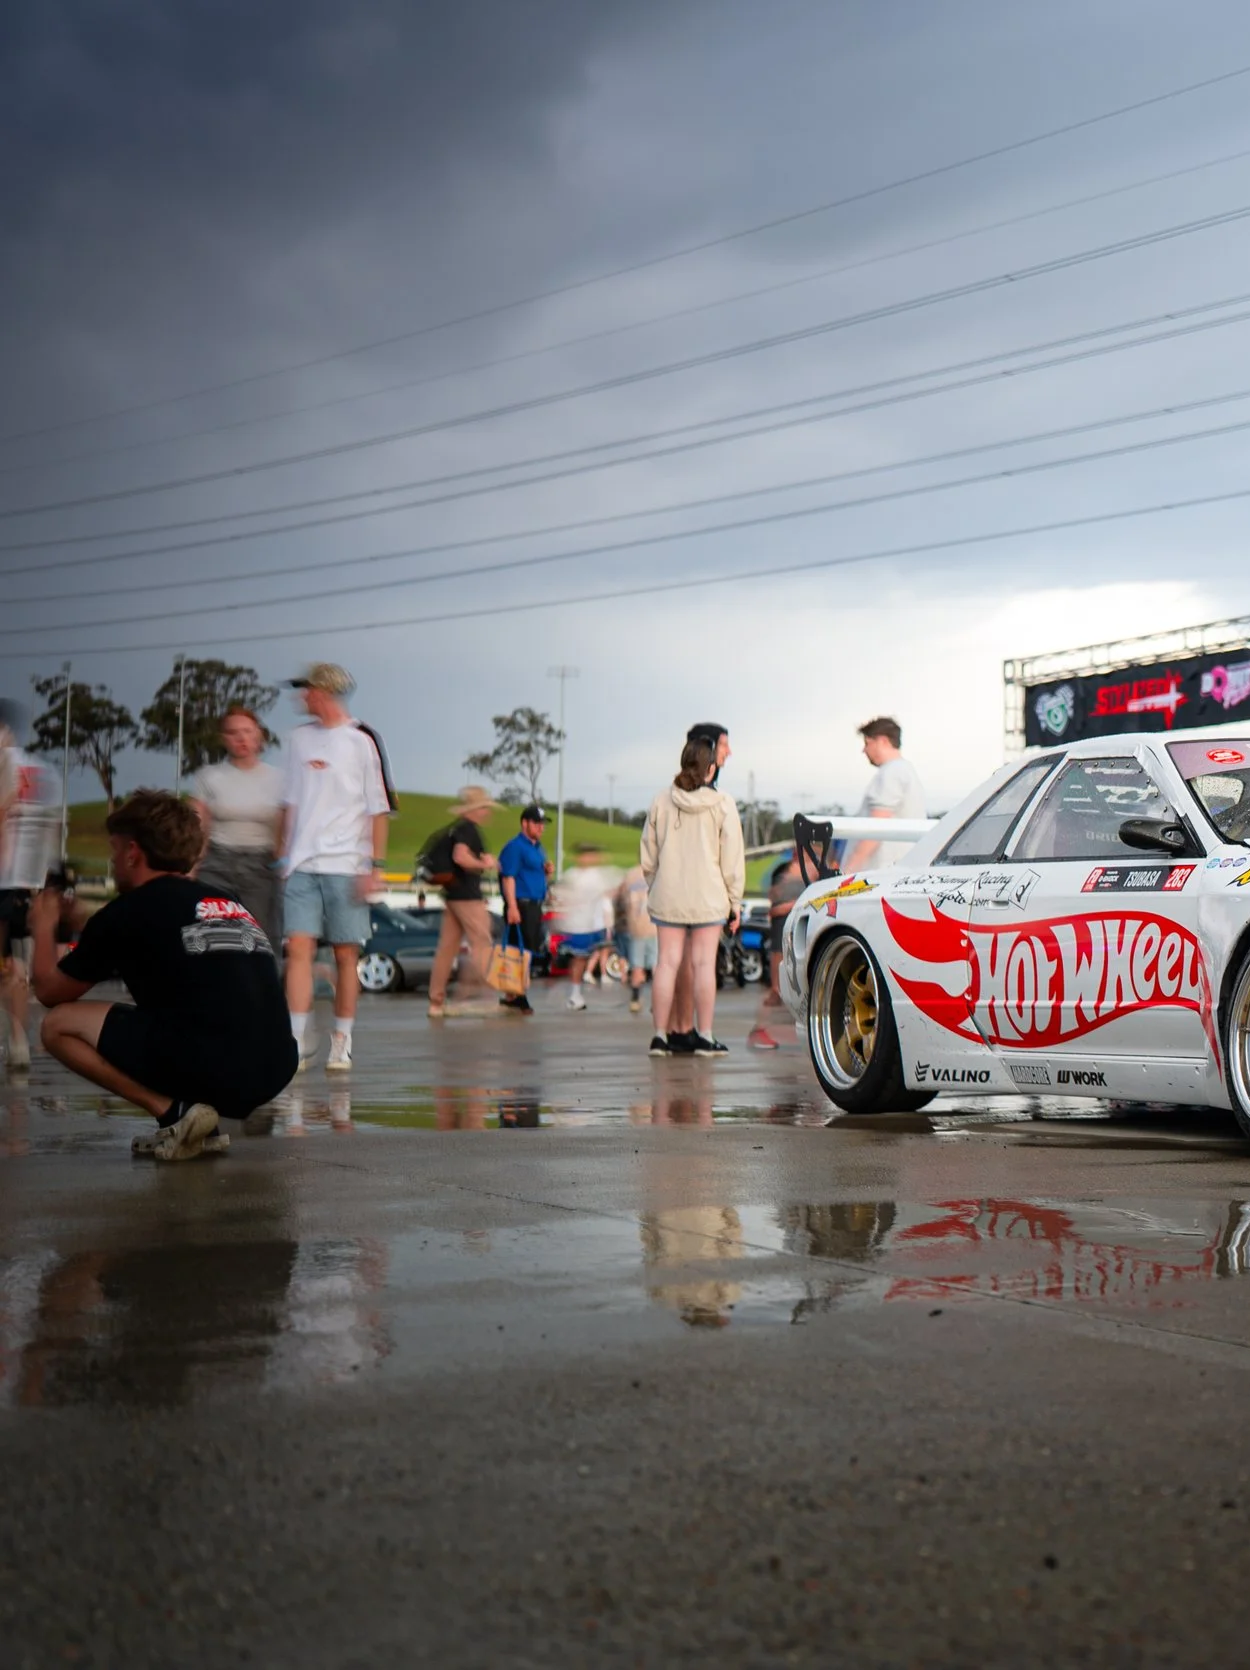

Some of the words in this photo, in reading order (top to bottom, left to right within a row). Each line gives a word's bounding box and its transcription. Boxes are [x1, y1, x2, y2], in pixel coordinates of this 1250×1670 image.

[1123, 870, 1163, 888] TSUBASA
[1164, 868, 1192, 888] 283
[932, 1068, 991, 1083] VALINO
[1072, 1070, 1108, 1087] WORK
